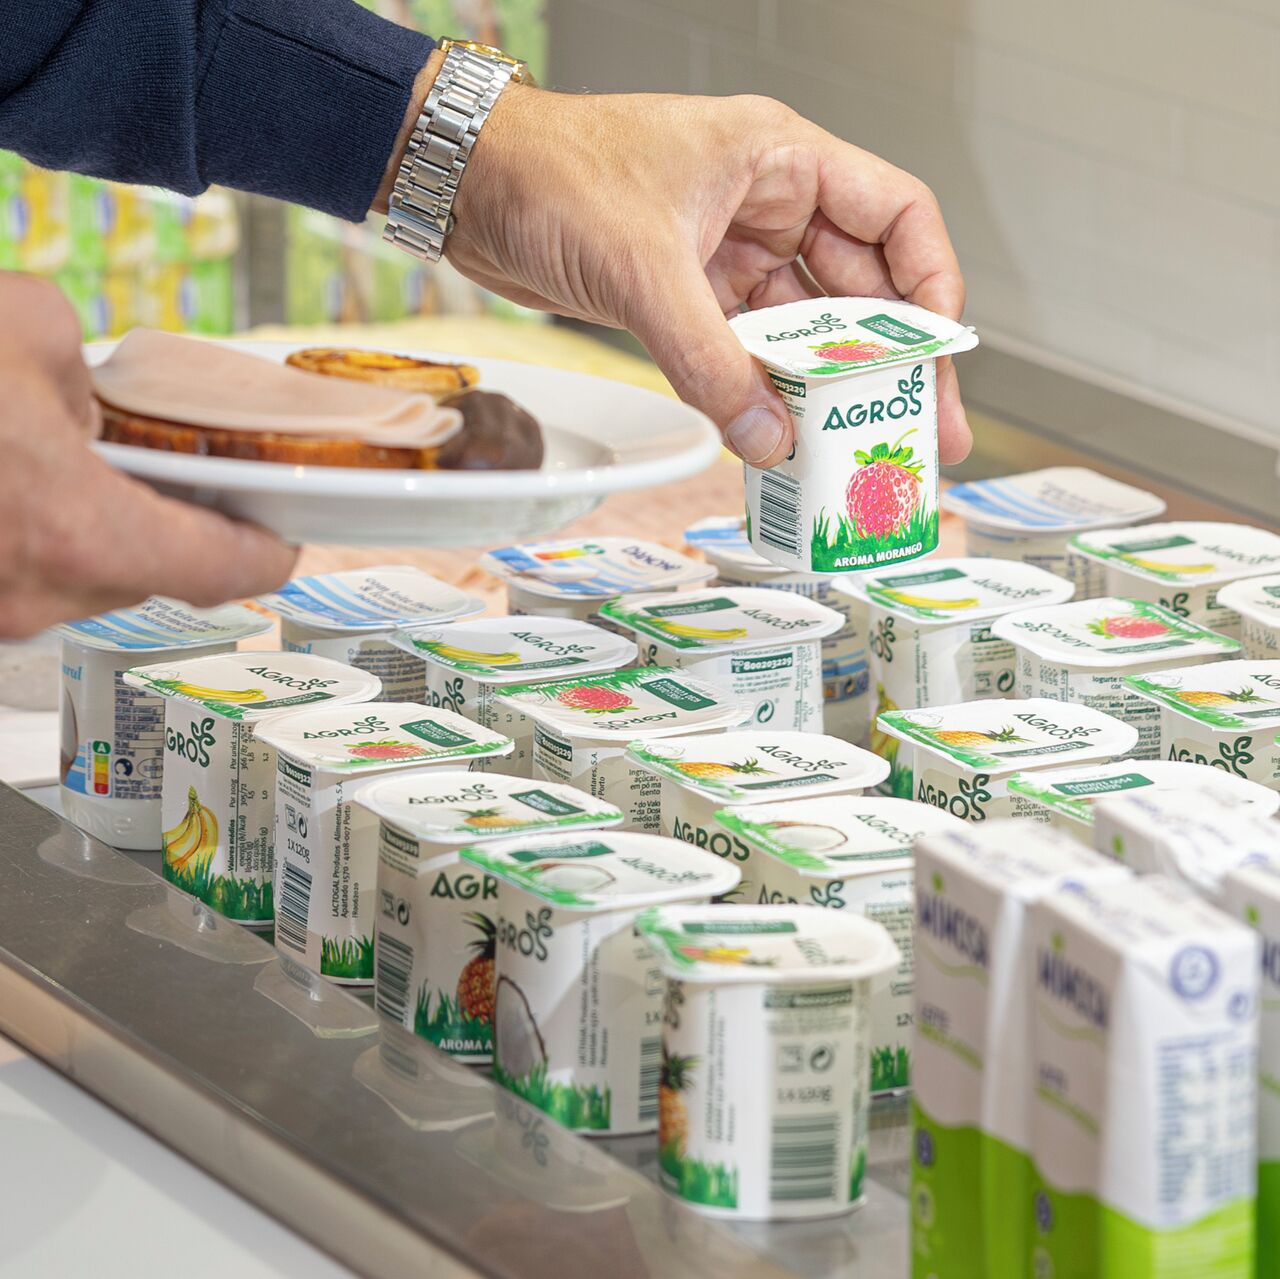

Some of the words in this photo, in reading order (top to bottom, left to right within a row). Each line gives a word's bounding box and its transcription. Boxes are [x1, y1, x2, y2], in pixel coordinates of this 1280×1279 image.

[764, 312, 848, 342] AGROS
[822, 364, 924, 431] AGROS
[834, 554, 874, 569] AROMA
[875, 541, 923, 563] MORANGO
[509, 630, 596, 656] AGROS
[246, 667, 339, 691] AGROS
[304, 715, 390, 739] AGROS
[1013, 713, 1102, 739] AGROS
[166, 717, 216, 768] GROS
[756, 745, 848, 772] AGROS
[408, 784, 498, 805] AGROS
[598, 776, 606, 796] Porto
[917, 774, 992, 822] AGROS
[334, 795, 342, 842] Alimentares,
[344, 805, 352, 826] Porto
[673, 816, 750, 862] AGROS
[333, 845, 341, 879] Produtos
[332, 880, 340, 918] LACTOGAL
[429, 872, 498, 900] AGR
[341, 883, 349, 918] Apartado
[439, 1038, 483, 1051] AROMA
